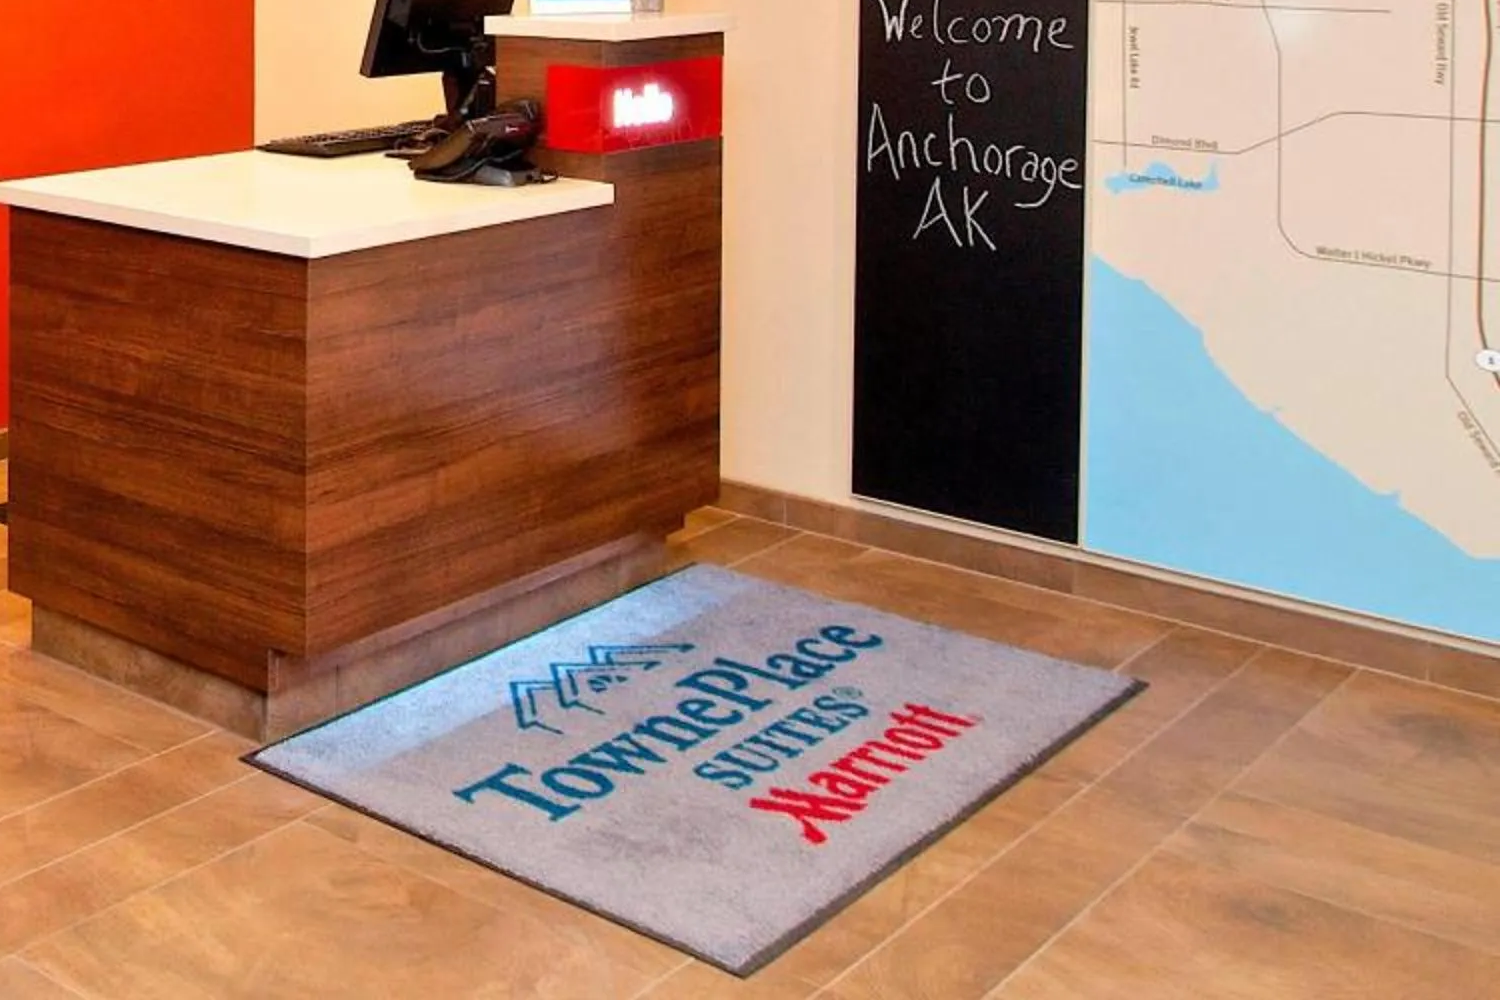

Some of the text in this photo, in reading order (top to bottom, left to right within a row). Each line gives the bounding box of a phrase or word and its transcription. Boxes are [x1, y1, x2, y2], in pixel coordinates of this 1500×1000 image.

[931, 58, 992, 105] to
[867, 102, 1083, 208] Anchorage
[912, 175, 997, 252] AK
[452, 624, 885, 823] TownePlace
[749, 702, 985, 846] Marriott
